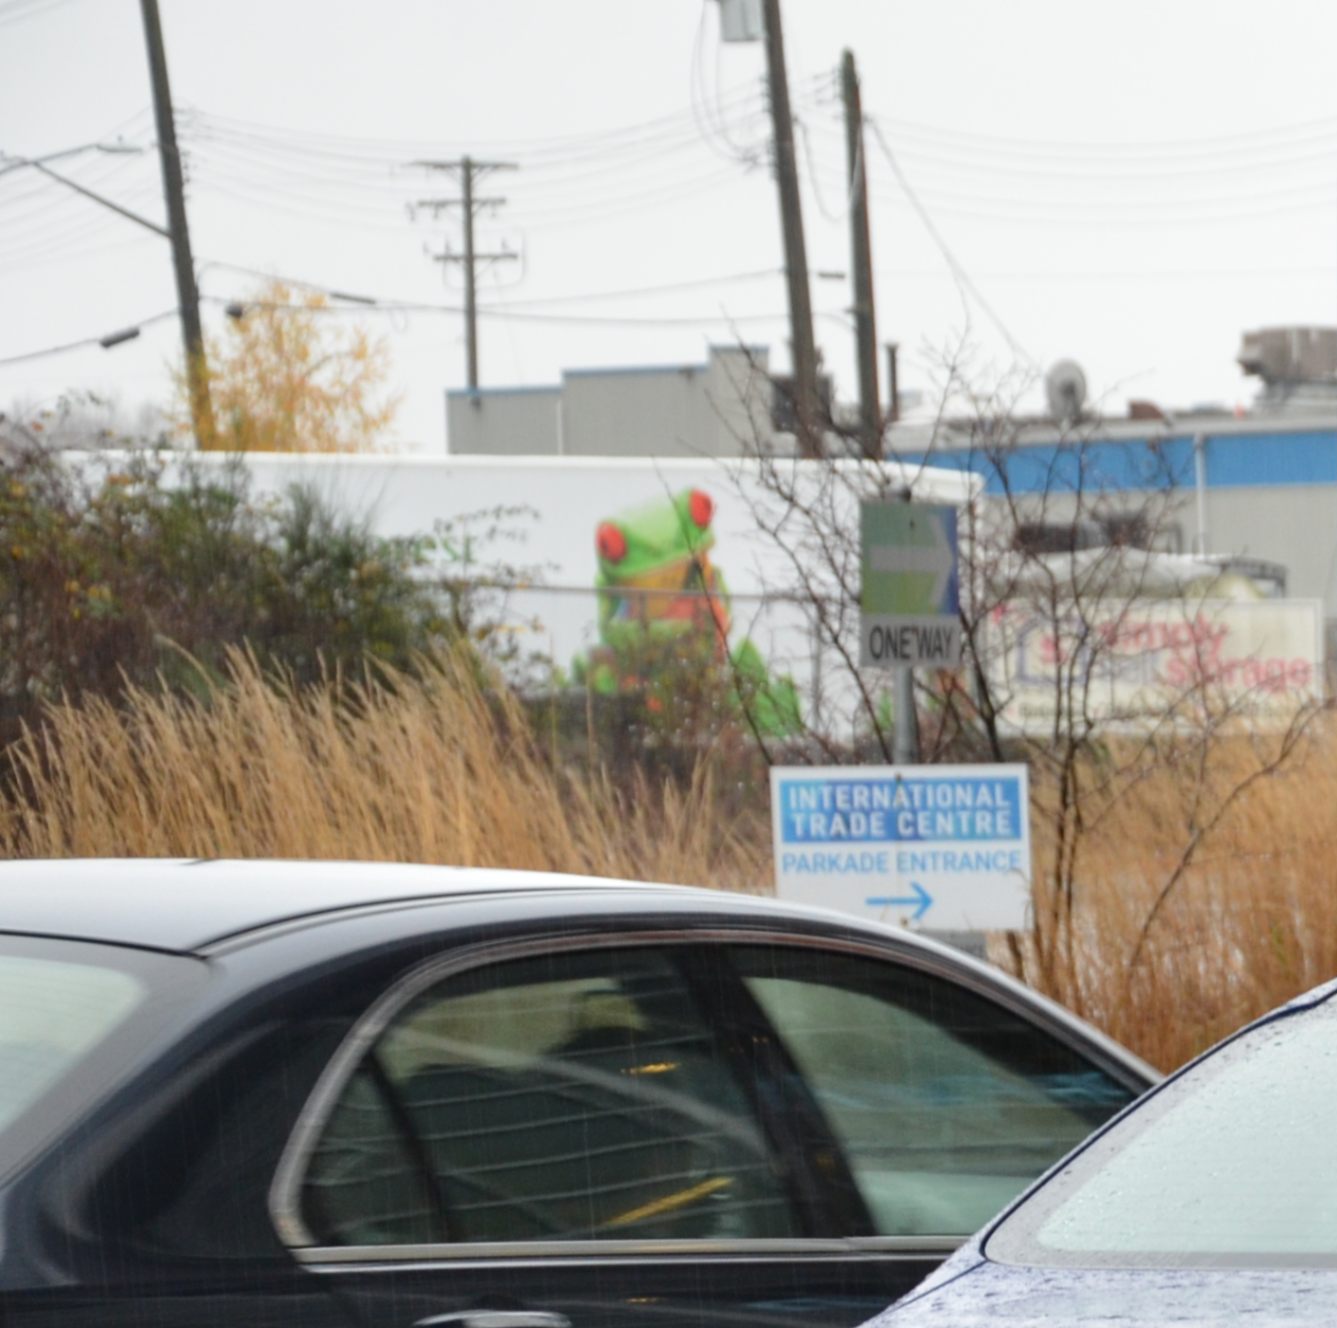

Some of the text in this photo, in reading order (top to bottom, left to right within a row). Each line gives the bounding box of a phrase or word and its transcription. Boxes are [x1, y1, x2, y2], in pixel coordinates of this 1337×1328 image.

[869, 624, 953, 660] ONE WAY
[789, 783, 1010, 810] INTERNATIONAL
[791, 809, 1012, 837] TRADE CENTRE
[782, 850, 1020, 874] PARKADE ENTRANCE
